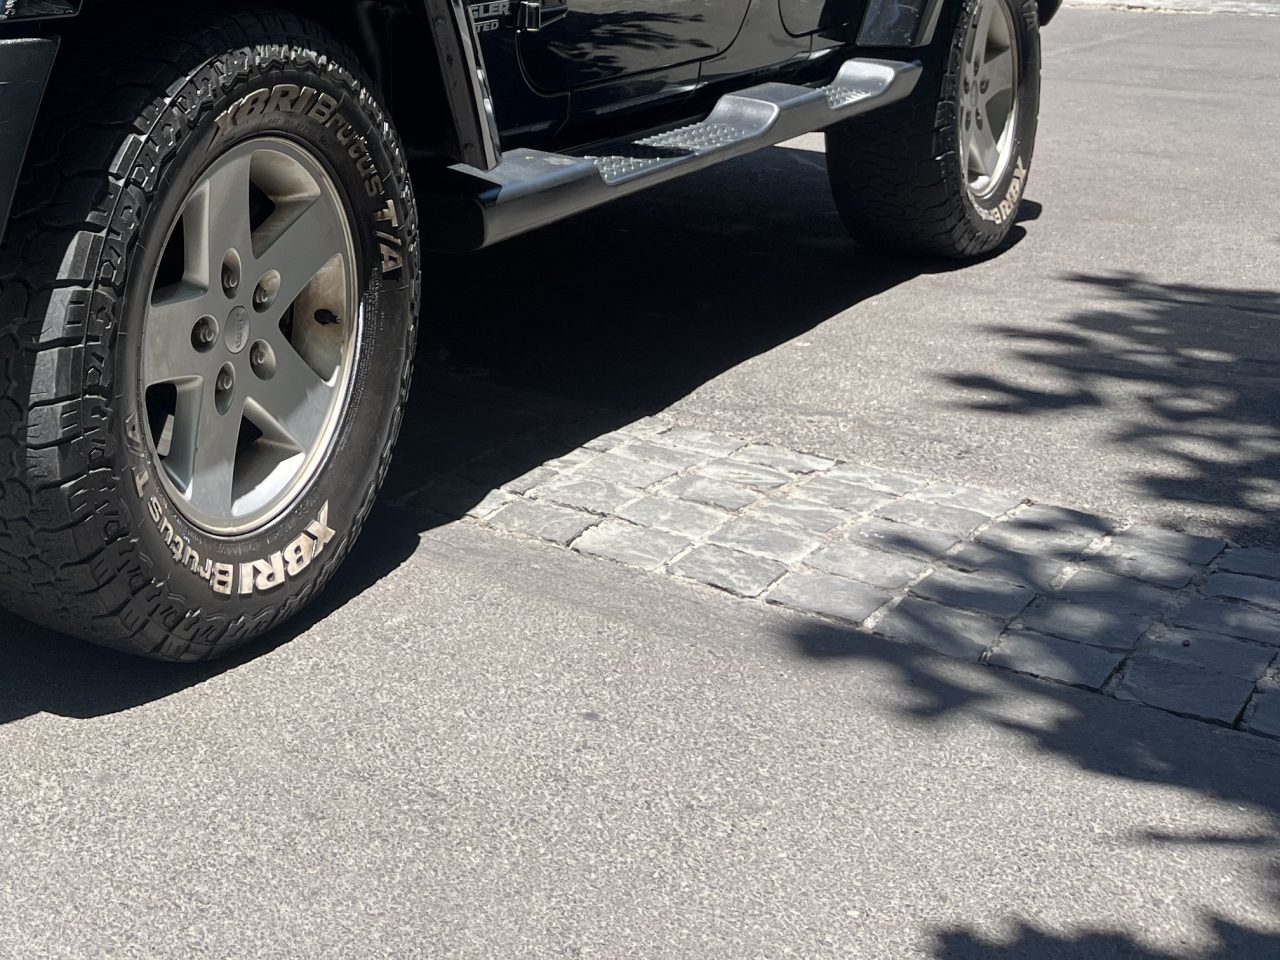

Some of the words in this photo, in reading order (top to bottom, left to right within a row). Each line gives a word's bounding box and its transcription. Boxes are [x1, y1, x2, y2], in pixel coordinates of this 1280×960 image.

[210, 83, 317, 147] XBRI
[307, 93, 385, 198] Brutus
[147, 494, 234, 596] Brutus
[238, 499, 336, 595] XBRI
